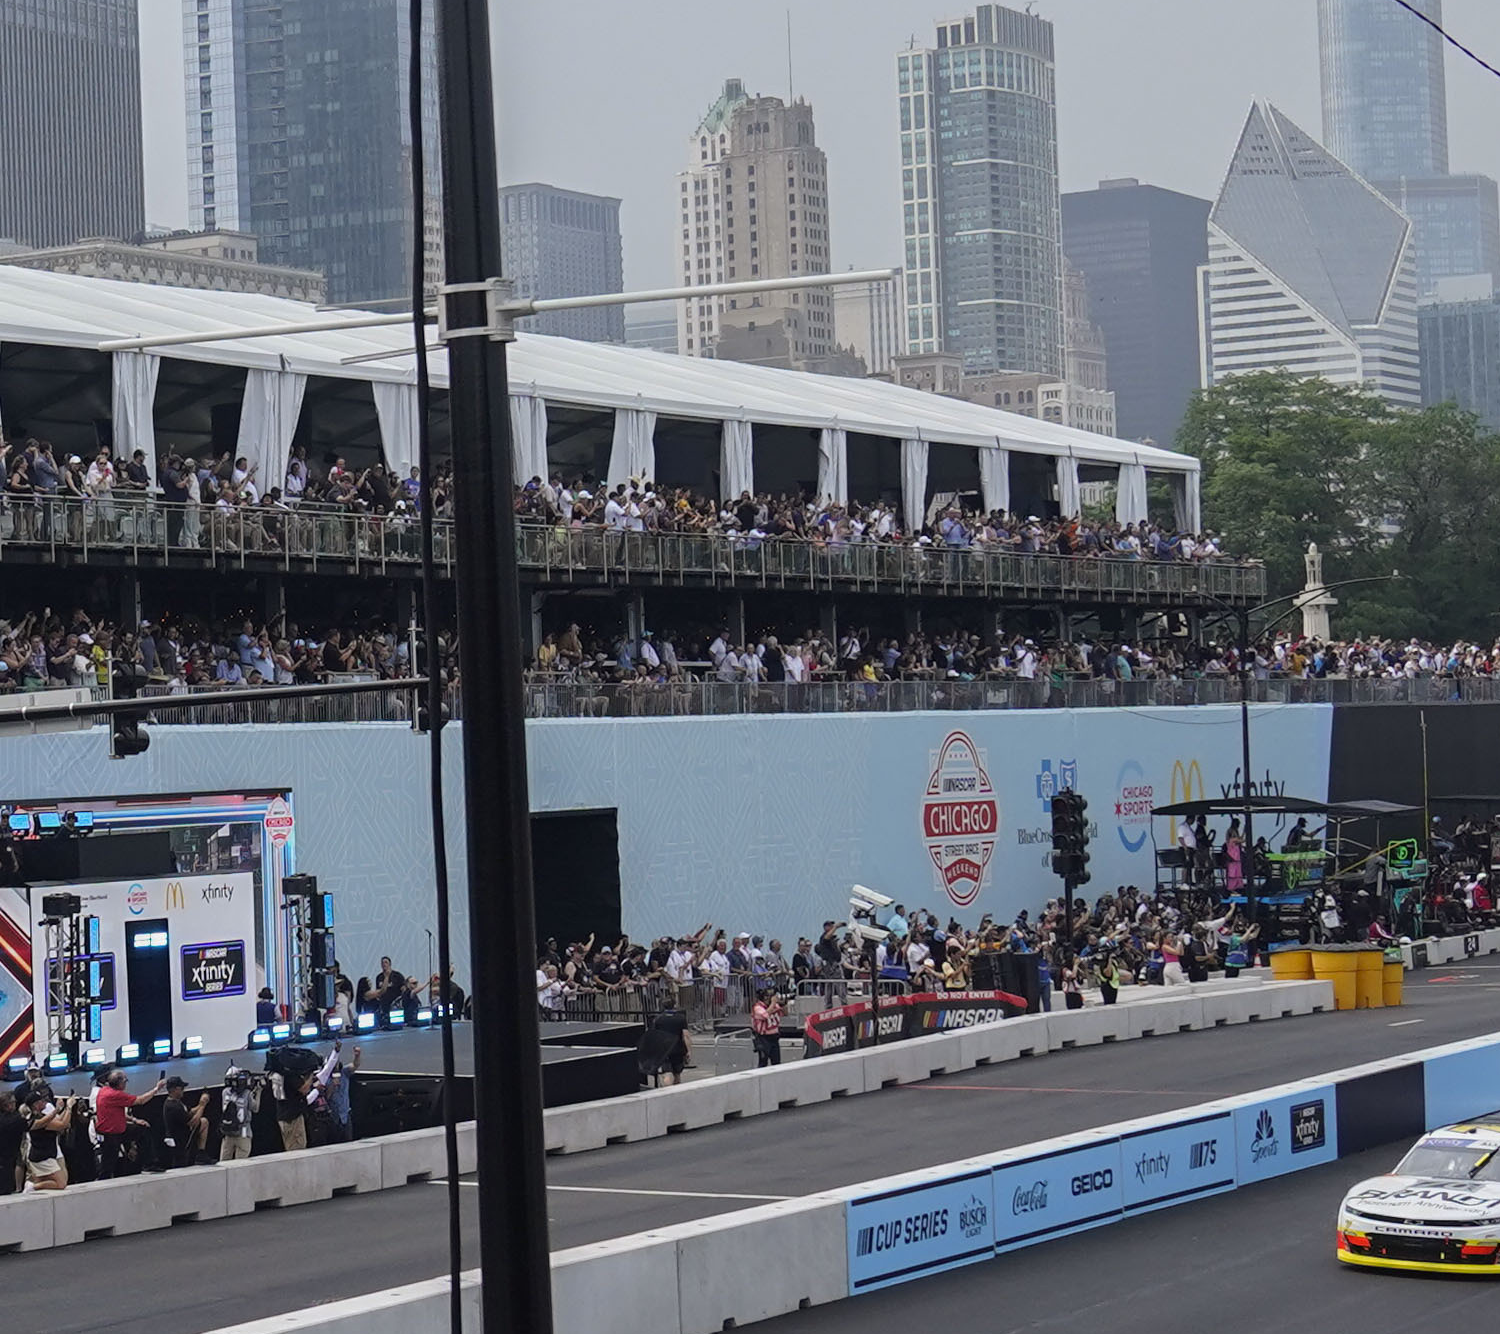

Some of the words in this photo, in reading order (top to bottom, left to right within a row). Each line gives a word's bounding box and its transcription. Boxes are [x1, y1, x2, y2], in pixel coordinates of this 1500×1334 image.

[946, 776, 977, 793] NASCAR
[1122, 785, 1153, 799] CHICAGO
[1123, 800, 1153, 816] SPORTS
[930, 803, 991, 835] CHICAGO
[1017, 827, 1053, 846] BlueCro
[944, 844, 965, 857] STREET
[965, 841, 980, 856] RACE
[946, 863, 980, 879] WEEKEND
[201, 883, 234, 904] xfinity
[1467, 936, 1478, 952] 24
[191, 960, 236, 988] xfinity
[968, 990, 996, 999] ENTER
[1295, 1117, 1320, 1142] xfinity
[1251, 1138, 1279, 1164] Sports
[1134, 1151, 1171, 1184] xfinity
[1071, 1168, 1113, 1196] GEICO
[960, 1203, 987, 1232] BUSCH
[875, 1221, 901, 1252] CUP
[904, 1208, 949, 1244] SERIES
[965, 1227, 982, 1238] LIGHT
[1374, 1226, 1454, 1237] CAMARO
